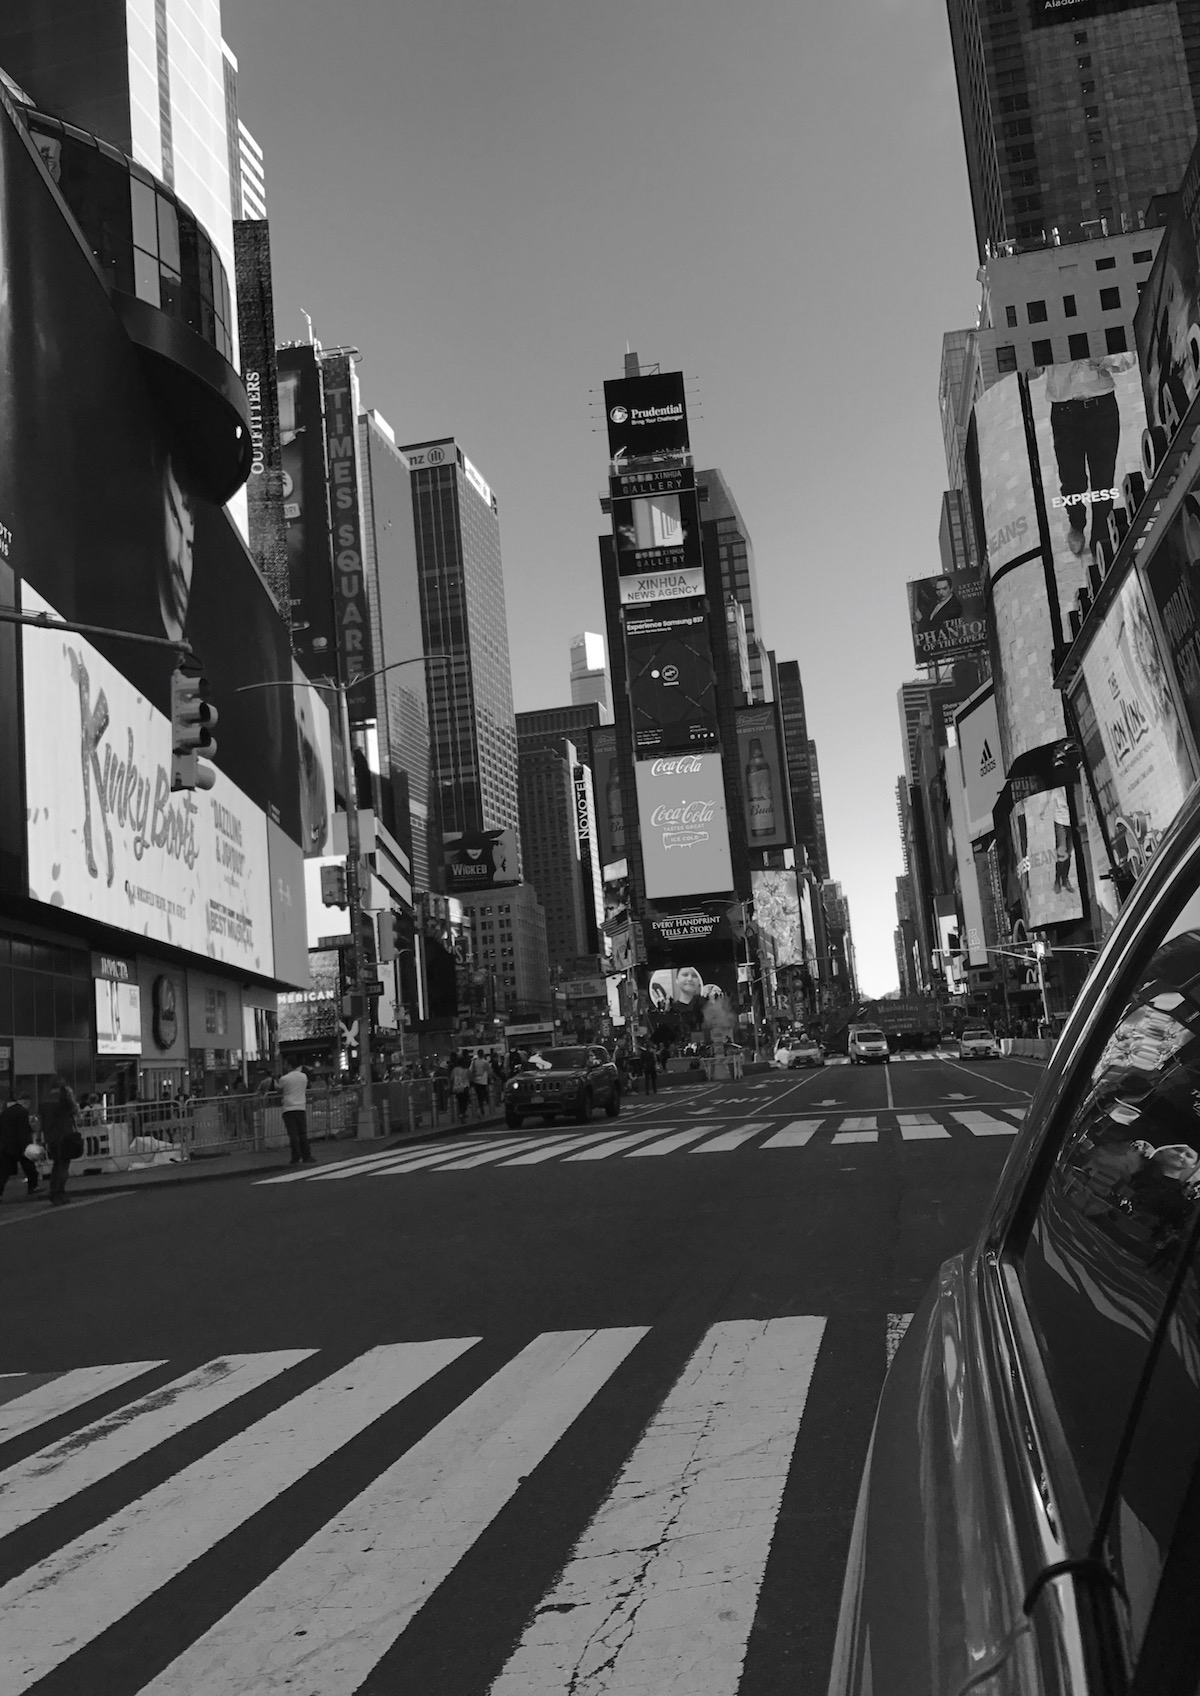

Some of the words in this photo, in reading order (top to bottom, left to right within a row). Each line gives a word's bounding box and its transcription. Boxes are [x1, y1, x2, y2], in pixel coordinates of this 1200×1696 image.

[631, 403, 683, 419] Prudential
[246, 371, 264, 475] OUTFITTERS
[326, 385, 356, 510] TIMES
[654, 470, 683, 481] XINHUA
[623, 479, 683, 494] GALLERY
[1052, 487, 1120, 508] EXPRESS
[990, 515, 1029, 556] EANS
[662, 547, 685, 557] XINHUA
[636, 555, 685, 567] GALLERY
[637, 575, 687, 591] XINHUA
[627, 589, 656, 601] NEWS
[657, 585, 698, 598] AGENCY
[335, 523, 368, 682] SQUARE
[626, 622, 662, 631] Experience
[662, 618, 692, 626] Samsung
[943, 617, 964, 628] THE
[923, 642, 936, 652] OF
[938, 638, 958, 649] THE
[651, 754, 704, 777] Coca-Cola
[979, 759, 997, 777] adidas
[575, 779, 590, 840] NOVOTEL
[651, 799, 717, 827] Coca-Cola
[1030, 846, 1069, 869] EANS
[652, 920, 675, 930] EVERY
[676, 915, 721, 927] HANDPRINT
[660, 926, 682, 937] TELLS
[689, 925, 714, 934] STORY
[277, 990, 335, 1004] MERICAN
